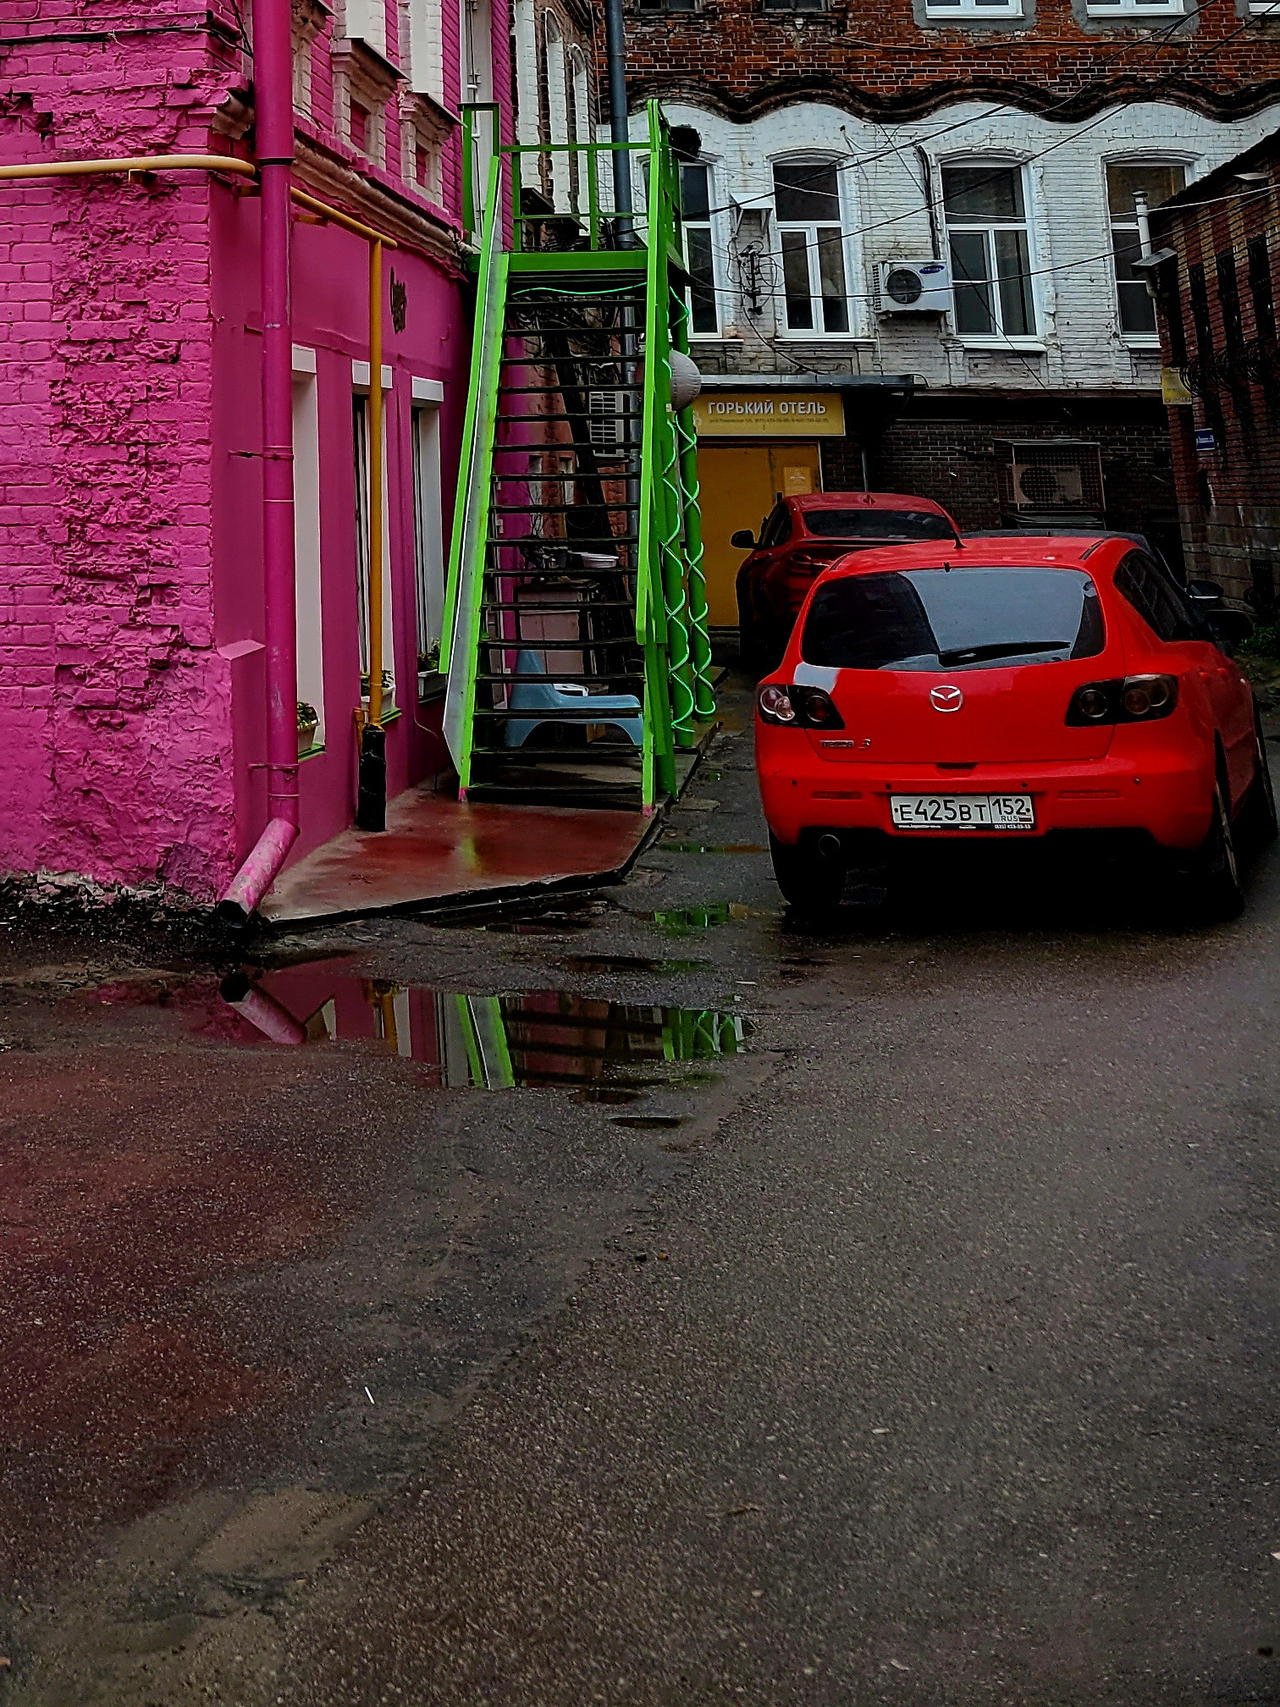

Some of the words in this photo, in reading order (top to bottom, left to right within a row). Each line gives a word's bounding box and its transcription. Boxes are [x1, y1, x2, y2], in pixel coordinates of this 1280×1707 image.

[708, 399, 774, 415] ГОРЬКИЙ
[779, 401, 827, 415] ОТЕЛЬ
[991, 798, 1027, 816] 152
